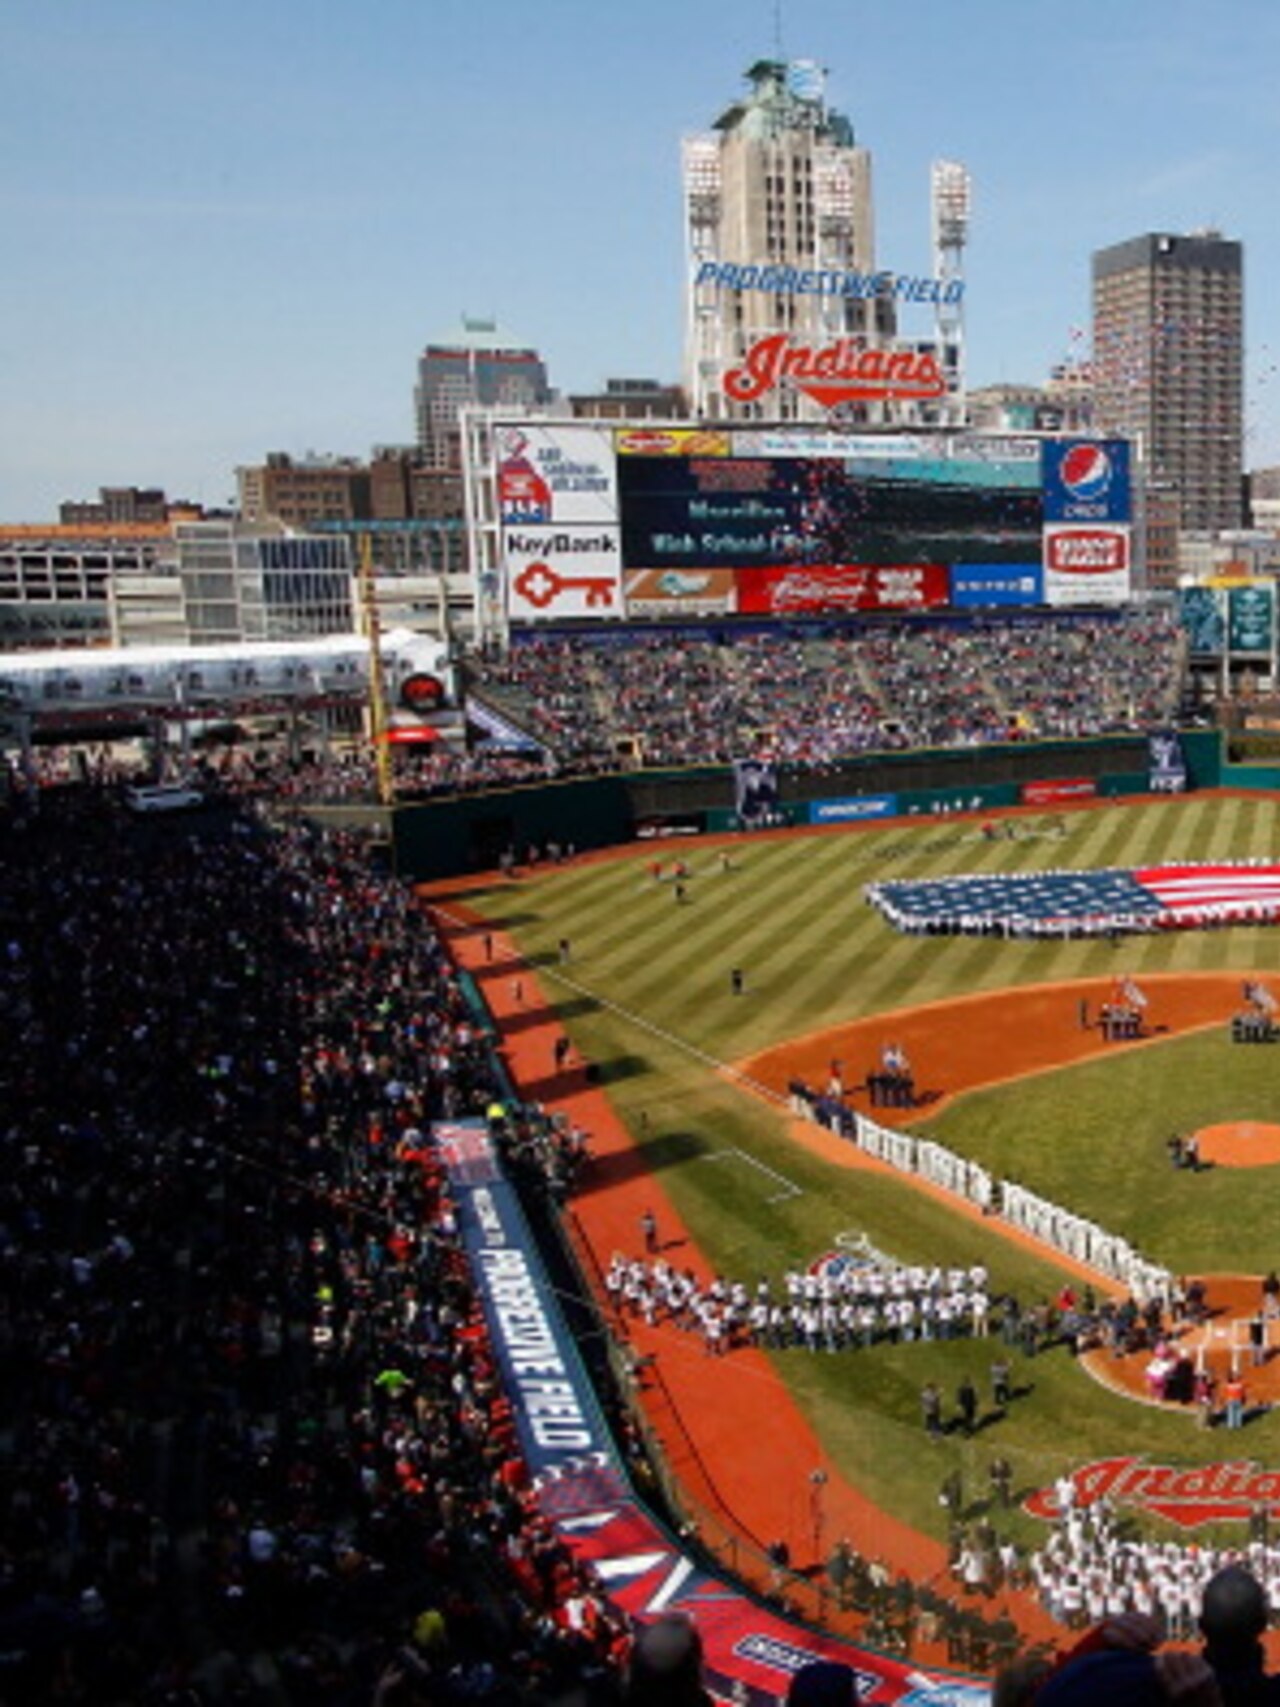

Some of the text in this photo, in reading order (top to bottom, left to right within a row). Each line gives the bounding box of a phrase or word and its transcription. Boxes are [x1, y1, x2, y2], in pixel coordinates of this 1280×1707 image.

[696, 261, 967, 304] PROGRESSIVE FIELD
[723, 333, 947, 404] Indians
[507, 533, 617, 557] KeyBank
[518, 1375, 592, 1451] FIELD
